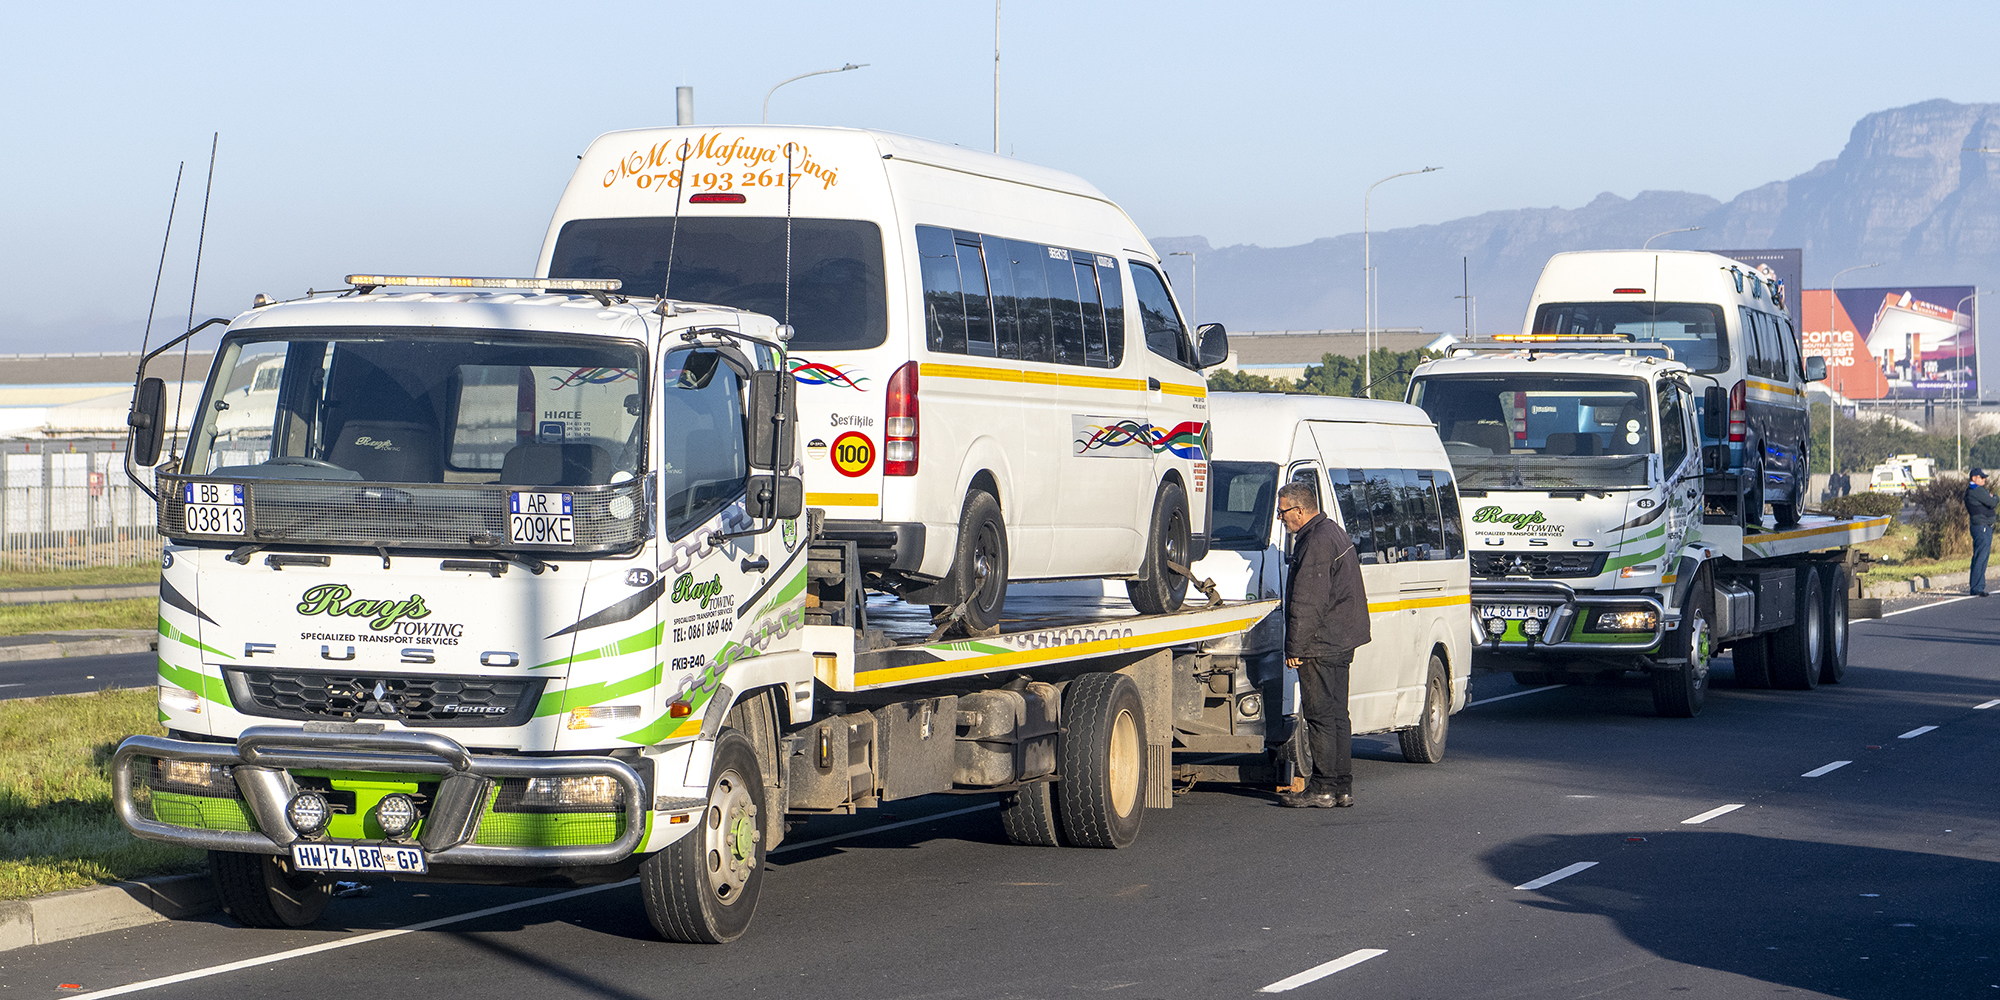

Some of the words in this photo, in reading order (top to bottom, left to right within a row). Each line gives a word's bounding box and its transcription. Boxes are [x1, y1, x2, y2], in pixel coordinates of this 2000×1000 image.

[637, 169, 682, 192] 078
[690, 172, 733, 191] 193
[741, 169, 802, 190] 2617
[1802, 348, 1854, 357] BIGGEST
[1825, 356, 1855, 367] AND
[544, 411, 582, 419] HIACE
[838, 444, 869, 464] 100
[201, 485, 220, 503] BB
[527, 494, 548, 513] AR
[187, 506, 244, 533] 03813
[513, 516, 573, 543] 209KE
[1526, 524, 1565, 533] TOWING
[1485, 537, 1595, 547] USO
[628, 571, 648, 584] 45
[709, 594, 735, 610] TOWING
[673, 614, 696, 626] SPECIALIZED
[696, 610, 717, 620] TRANSPORT
[1483, 605, 1495, 617] KZ
[1500, 605, 1512, 617] 86
[1516, 606, 1529, 617] FX
[1537, 606, 1549, 618] GP
[393, 621, 464, 638] TOWING
[673, 627, 687, 643] TEL:
[688, 622, 705, 640] 0861
[706, 619, 720, 636] 869
[720, 616, 733, 632] 466
[300, 632, 356, 642] SPECIALIZED
[358, 634, 413, 644] TRANSPORT
[415, 636, 459, 646] SERVICES
[244, 642, 520, 667] FUSO
[442, 704, 506, 714] FIGHTER
[298, 847, 322, 867] HW
[329, 848, 352, 867] 74
[358, 849, 383, 868] BR
[397, 850, 419, 869] GP
